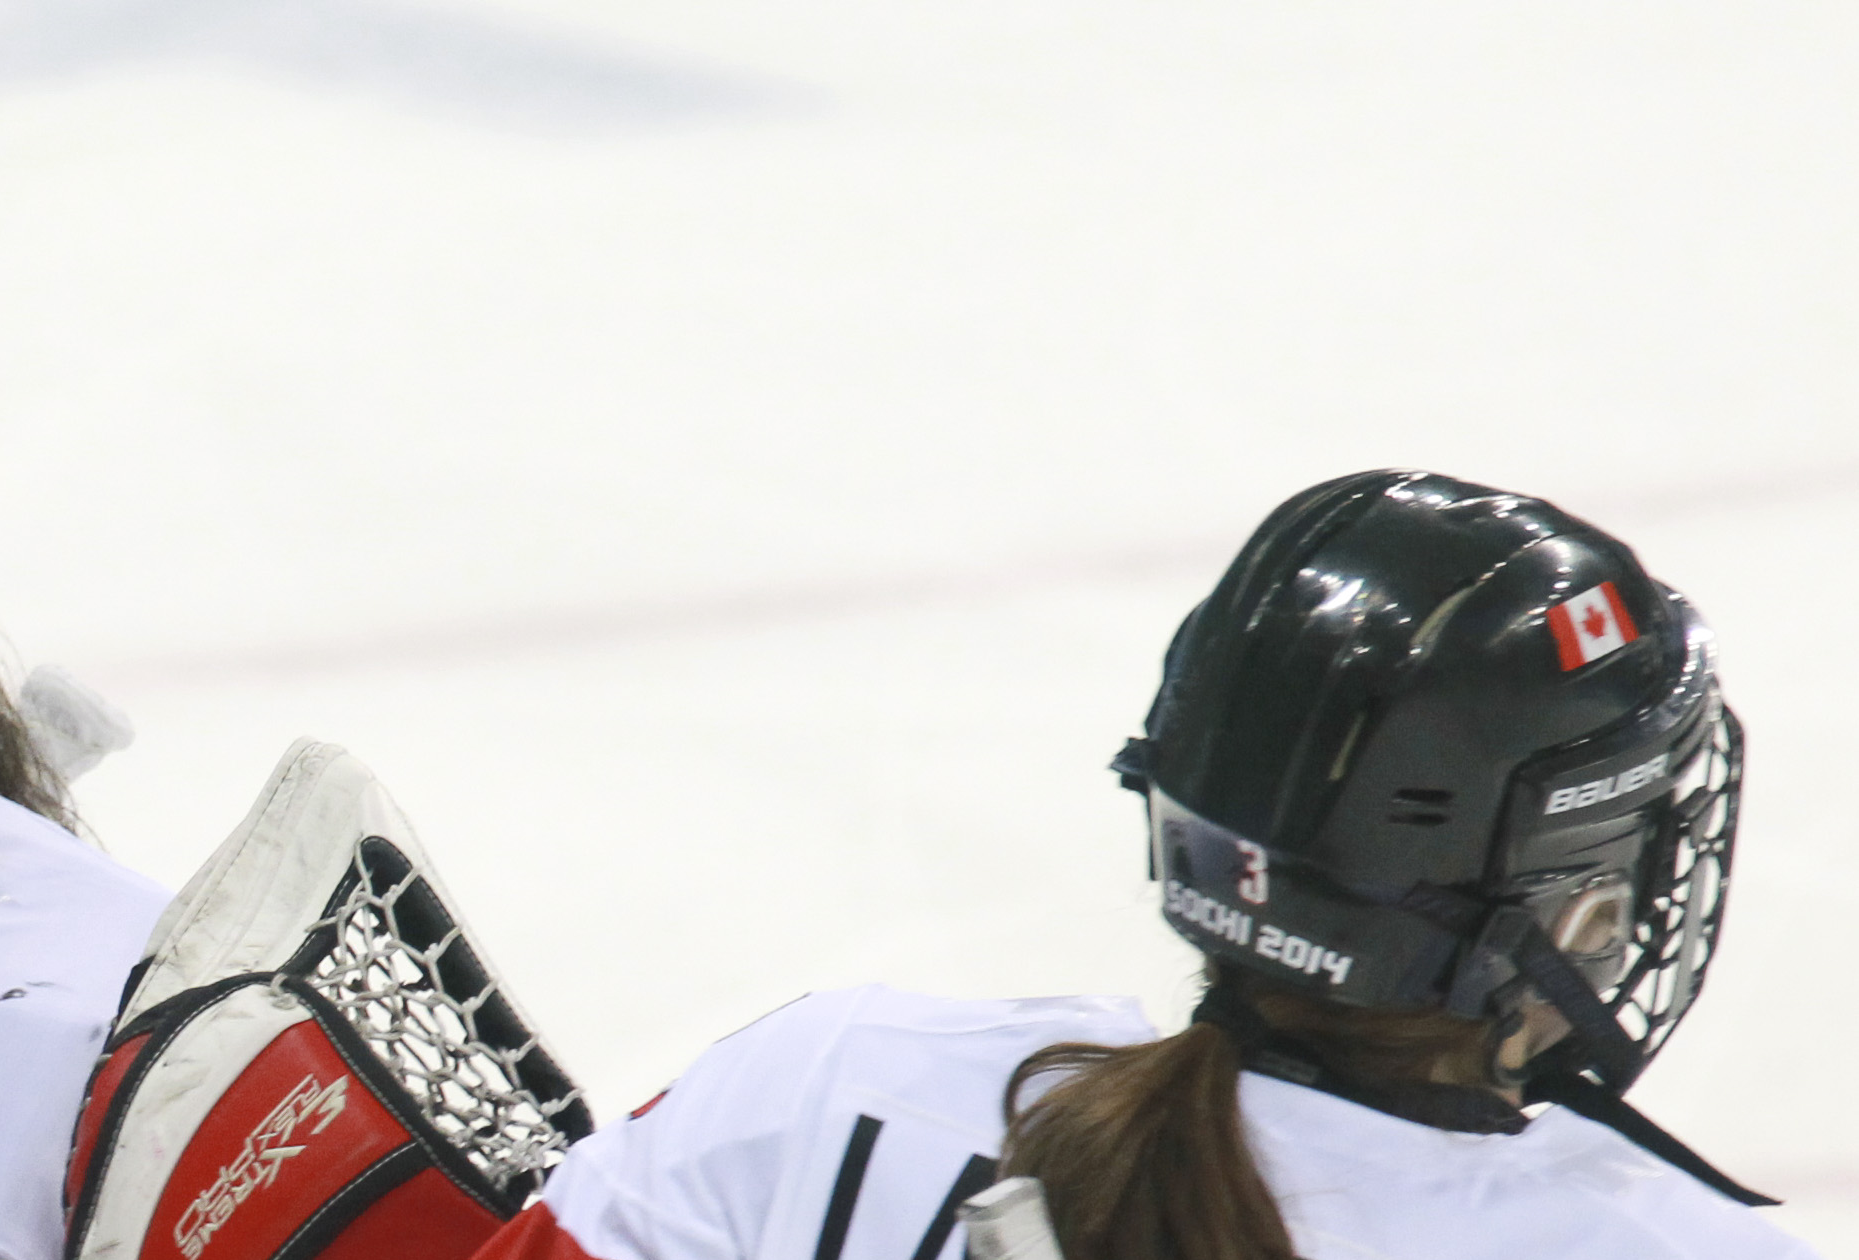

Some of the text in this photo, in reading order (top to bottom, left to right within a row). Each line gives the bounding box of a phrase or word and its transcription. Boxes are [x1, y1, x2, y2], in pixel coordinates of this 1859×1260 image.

[1544, 752, 1670, 815] BAUER
[1236, 838, 1269, 905] 3
[1165, 878, 1354, 986] SOCHI 2014
[173, 1136, 257, 1248] PRO
